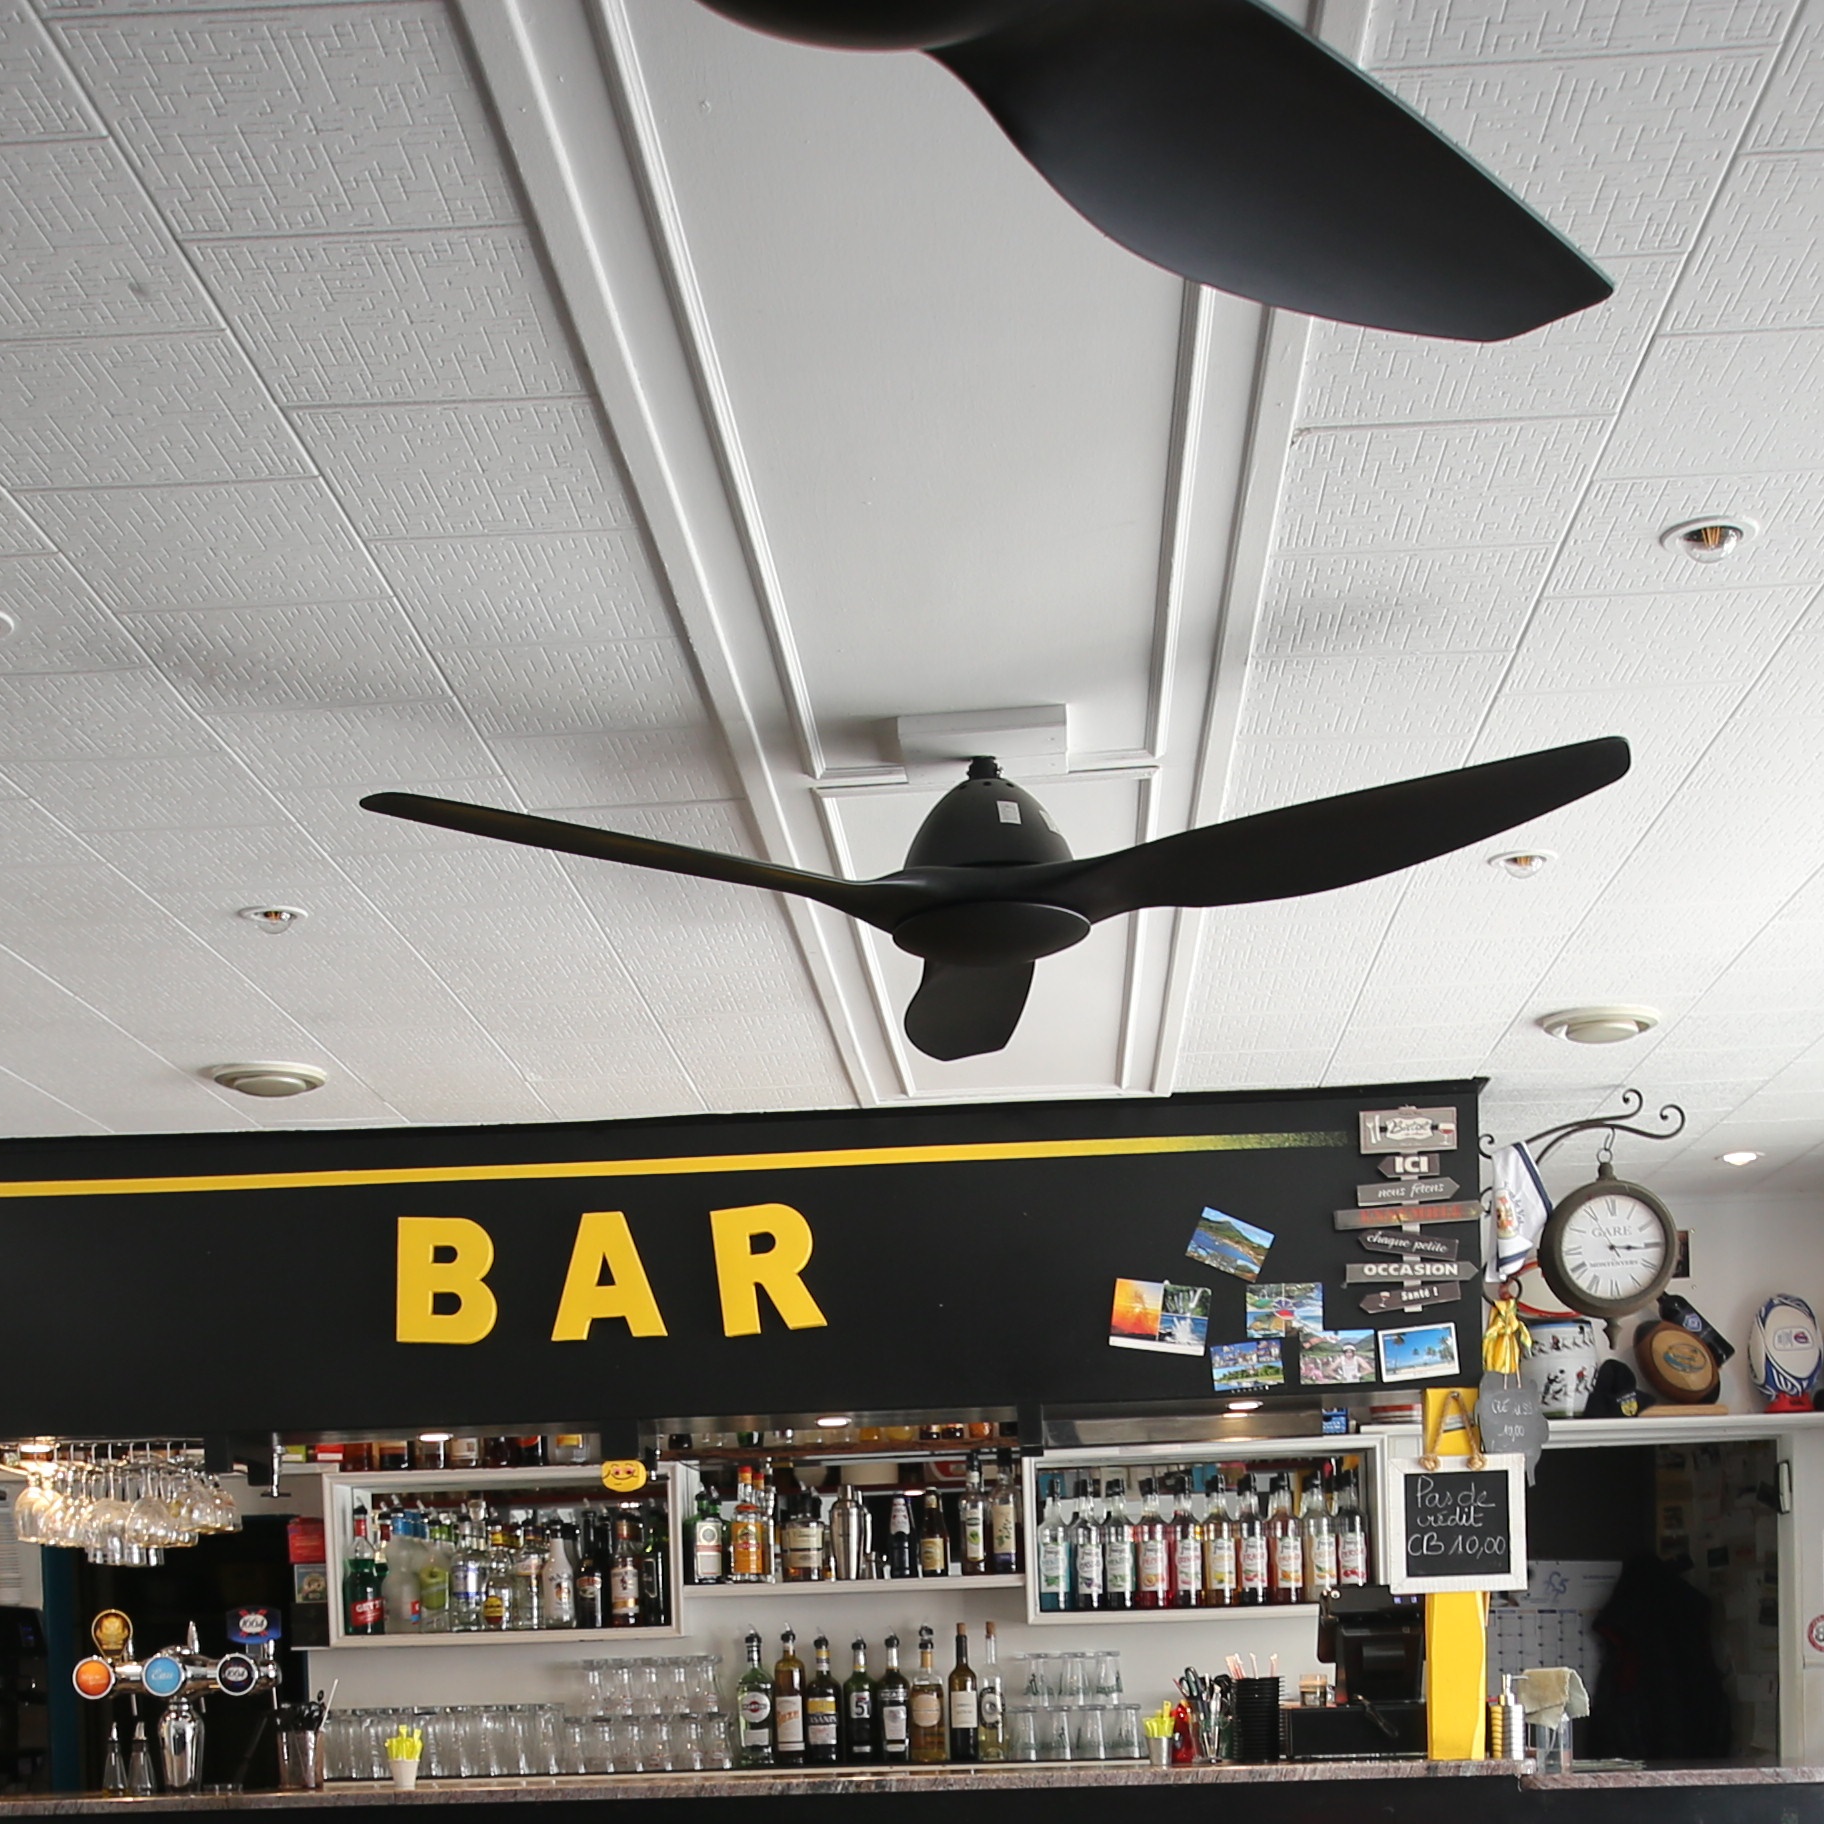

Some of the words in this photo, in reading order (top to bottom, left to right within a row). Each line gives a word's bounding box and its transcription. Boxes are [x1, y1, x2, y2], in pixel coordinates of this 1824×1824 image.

[1394, 1155, 1429, 1174] ICI
[1377, 1187, 1407, 1199] nous
[1591, 1225, 1633, 1238] GARE
[1365, 1231, 1412, 1249] chaque
[1412, 1240, 1449, 1253] petite
[395, 1202, 829, 1346] BAR
[1362, 1262, 1459, 1277] OCCASION
[1400, 1287, 1431, 1302] Santé
[1416, 1474, 1454, 1509] Pas
[1457, 1481, 1496, 1508] de
[1407, 1531, 1445, 1557] CB
[1447, 1534, 1506, 1560] 10,00
[240, 1618, 267, 1630] 1664
[855, 1701, 871, 1717] 51
